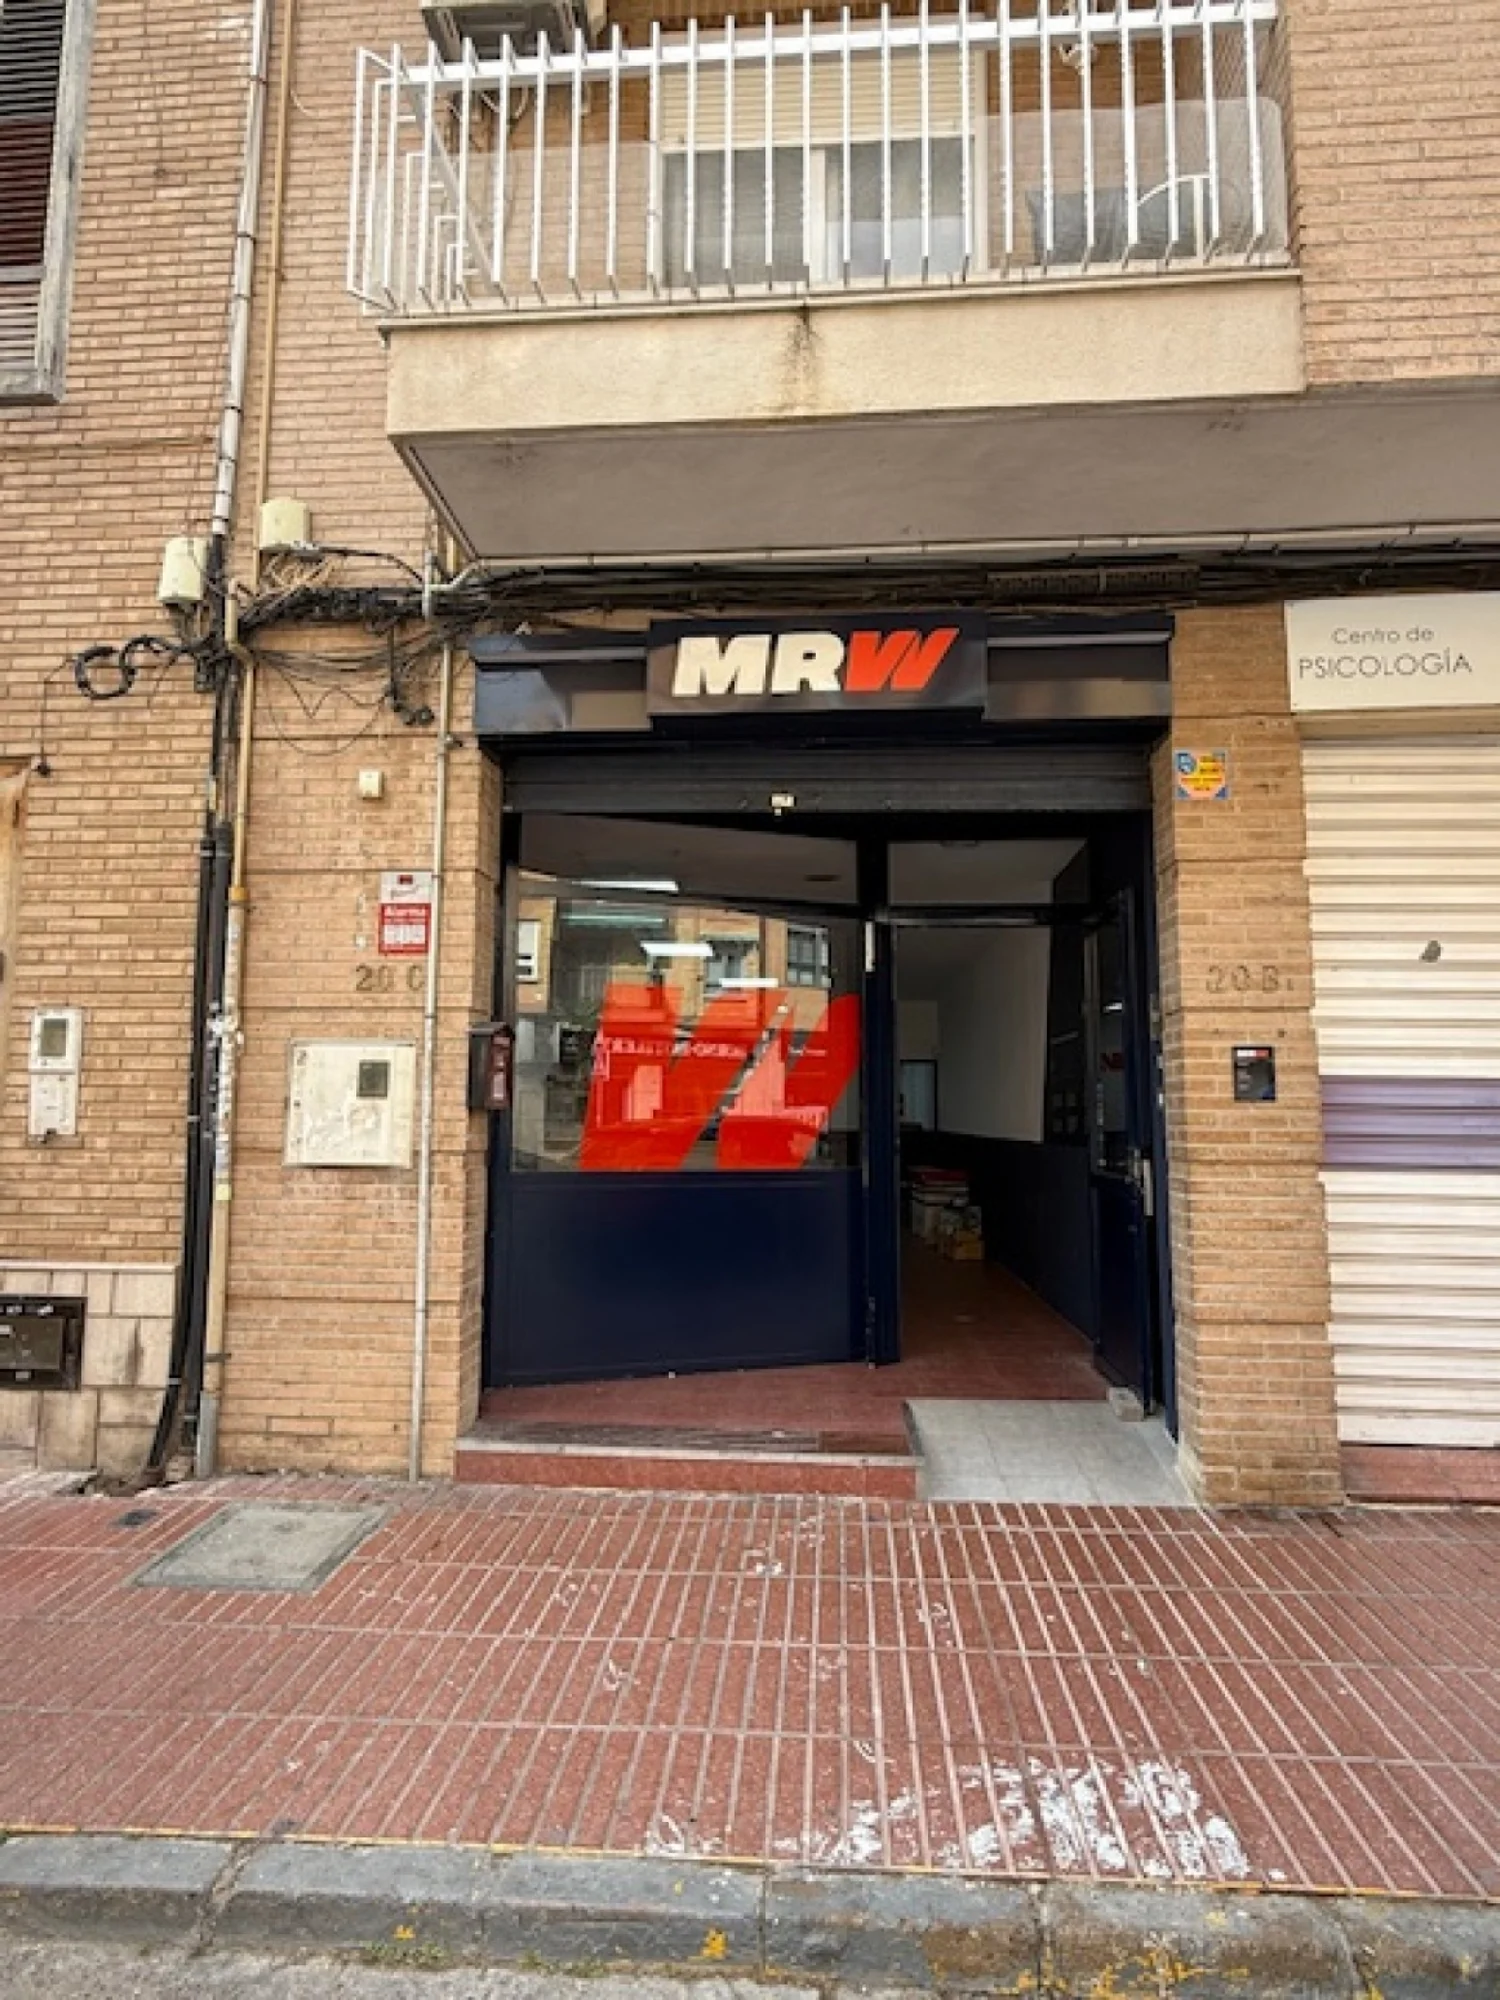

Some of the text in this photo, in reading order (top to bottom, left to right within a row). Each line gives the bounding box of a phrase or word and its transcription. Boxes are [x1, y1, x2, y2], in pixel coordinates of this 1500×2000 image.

[1332, 626, 1435, 645] Centro de
[672, 628, 959, 695] MRW
[1299, 648, 1473, 679] PSICOLOGÍA
